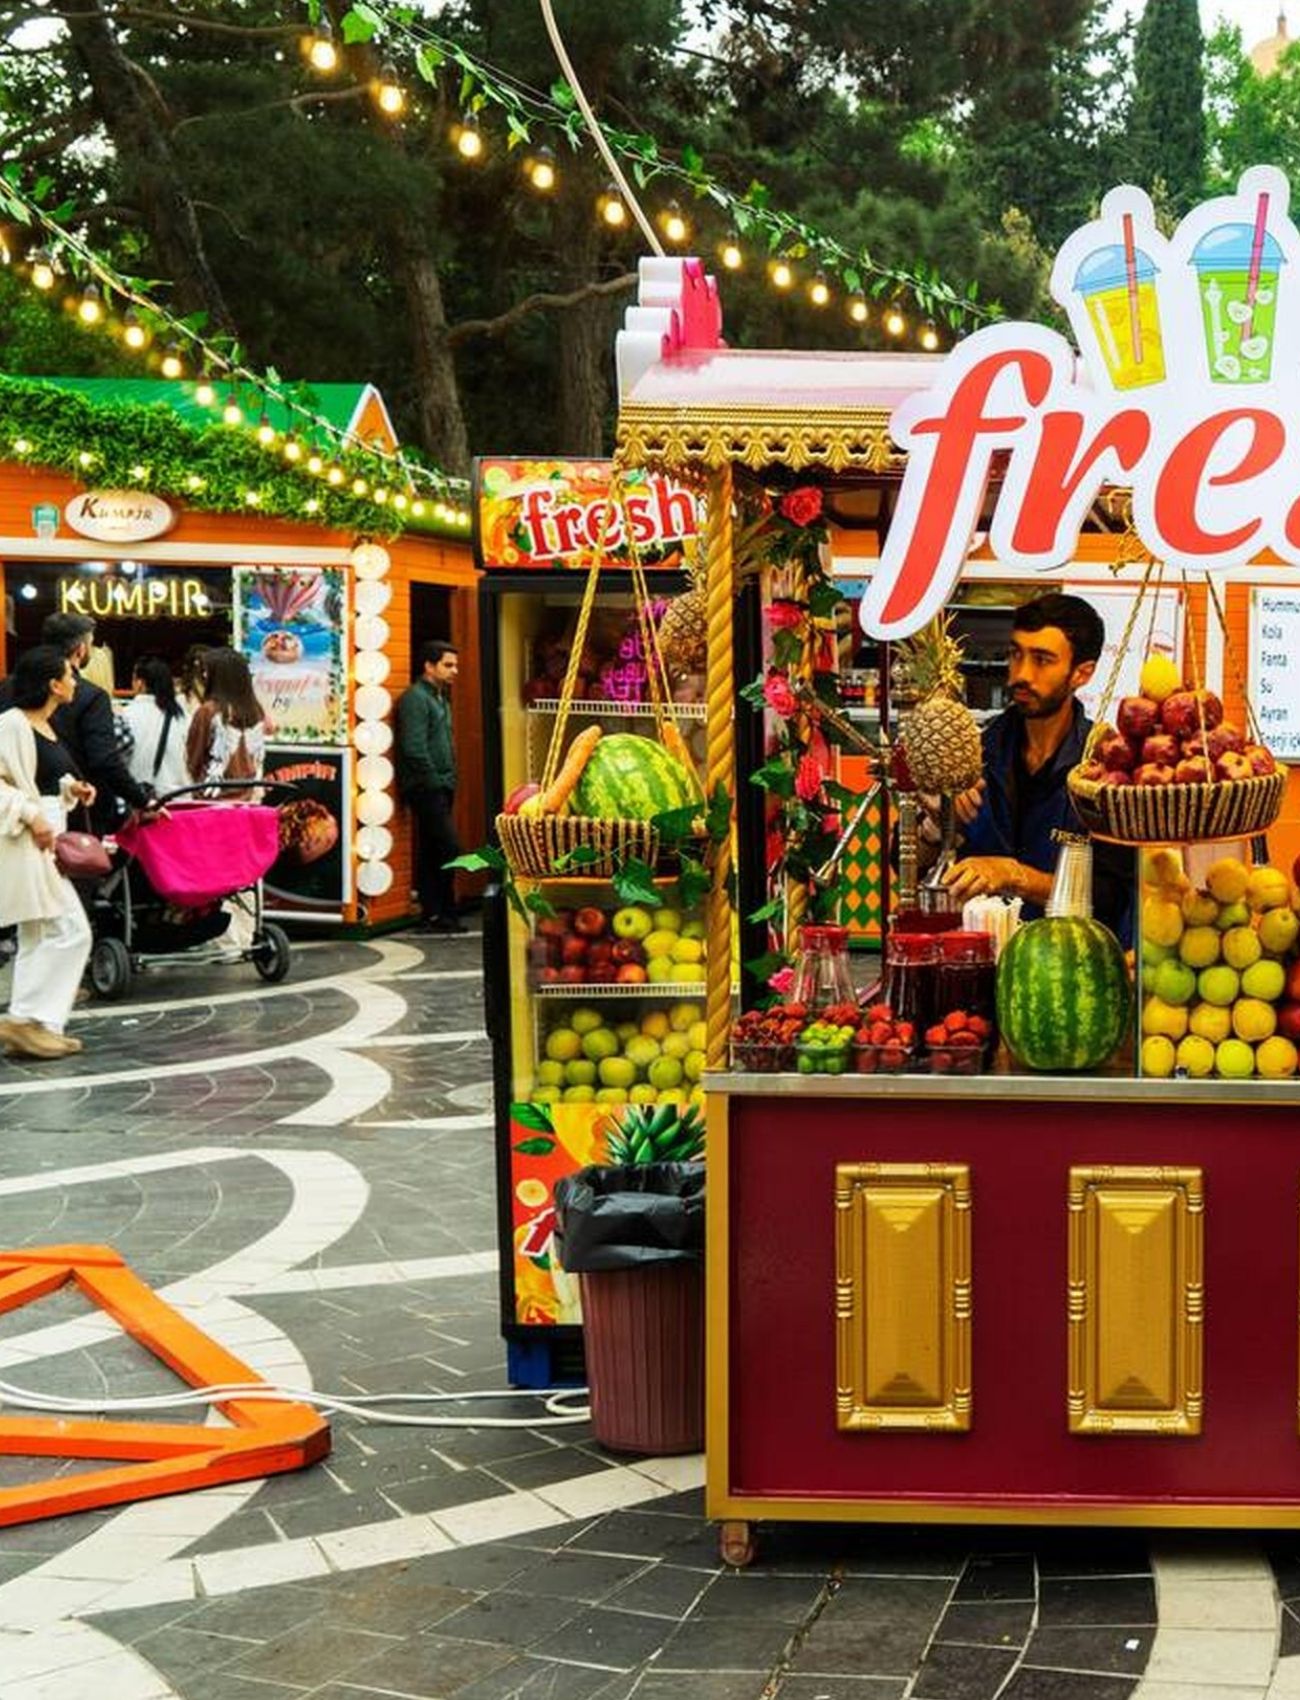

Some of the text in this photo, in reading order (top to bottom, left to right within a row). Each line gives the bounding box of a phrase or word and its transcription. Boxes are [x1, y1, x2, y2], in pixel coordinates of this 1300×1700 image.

[523, 478, 701, 557] fresh
[61, 579, 209, 616] KUMPIR
[1261, 624, 1283, 640] Kola
